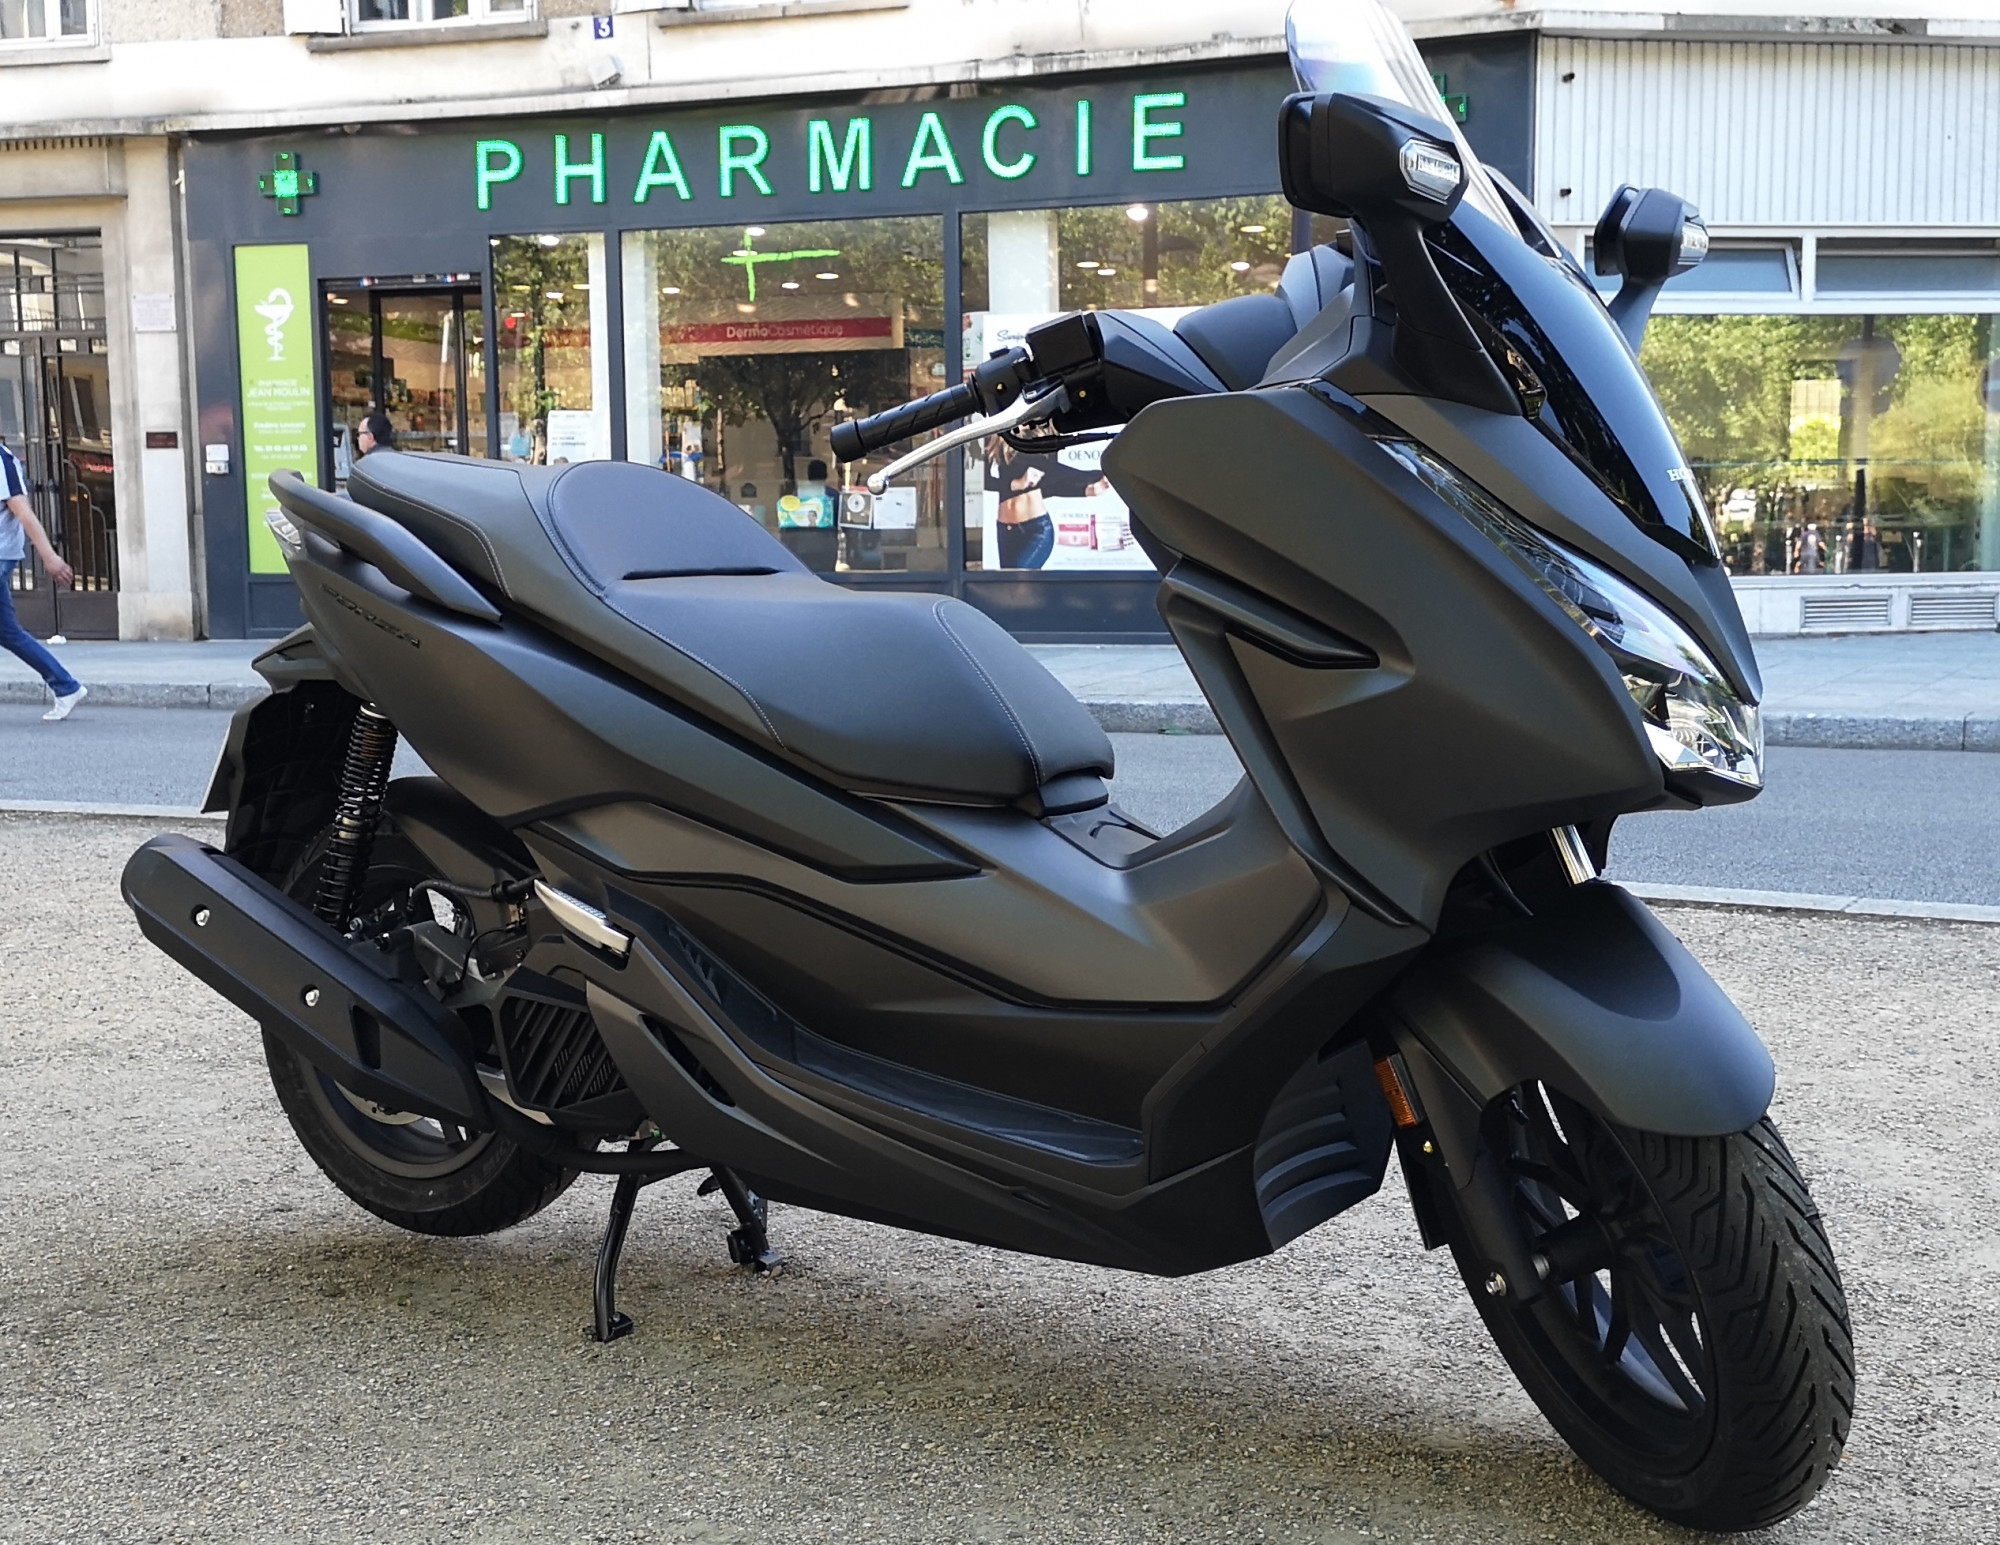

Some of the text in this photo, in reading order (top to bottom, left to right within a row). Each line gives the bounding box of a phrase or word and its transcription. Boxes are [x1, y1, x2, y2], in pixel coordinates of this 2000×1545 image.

[598, 16, 611, 38] 3
[474, 91, 1186, 211] PHARMACIE
[247, 386, 311, 398] JEAN MOULIN
[1069, 450, 1103, 461] OENO
